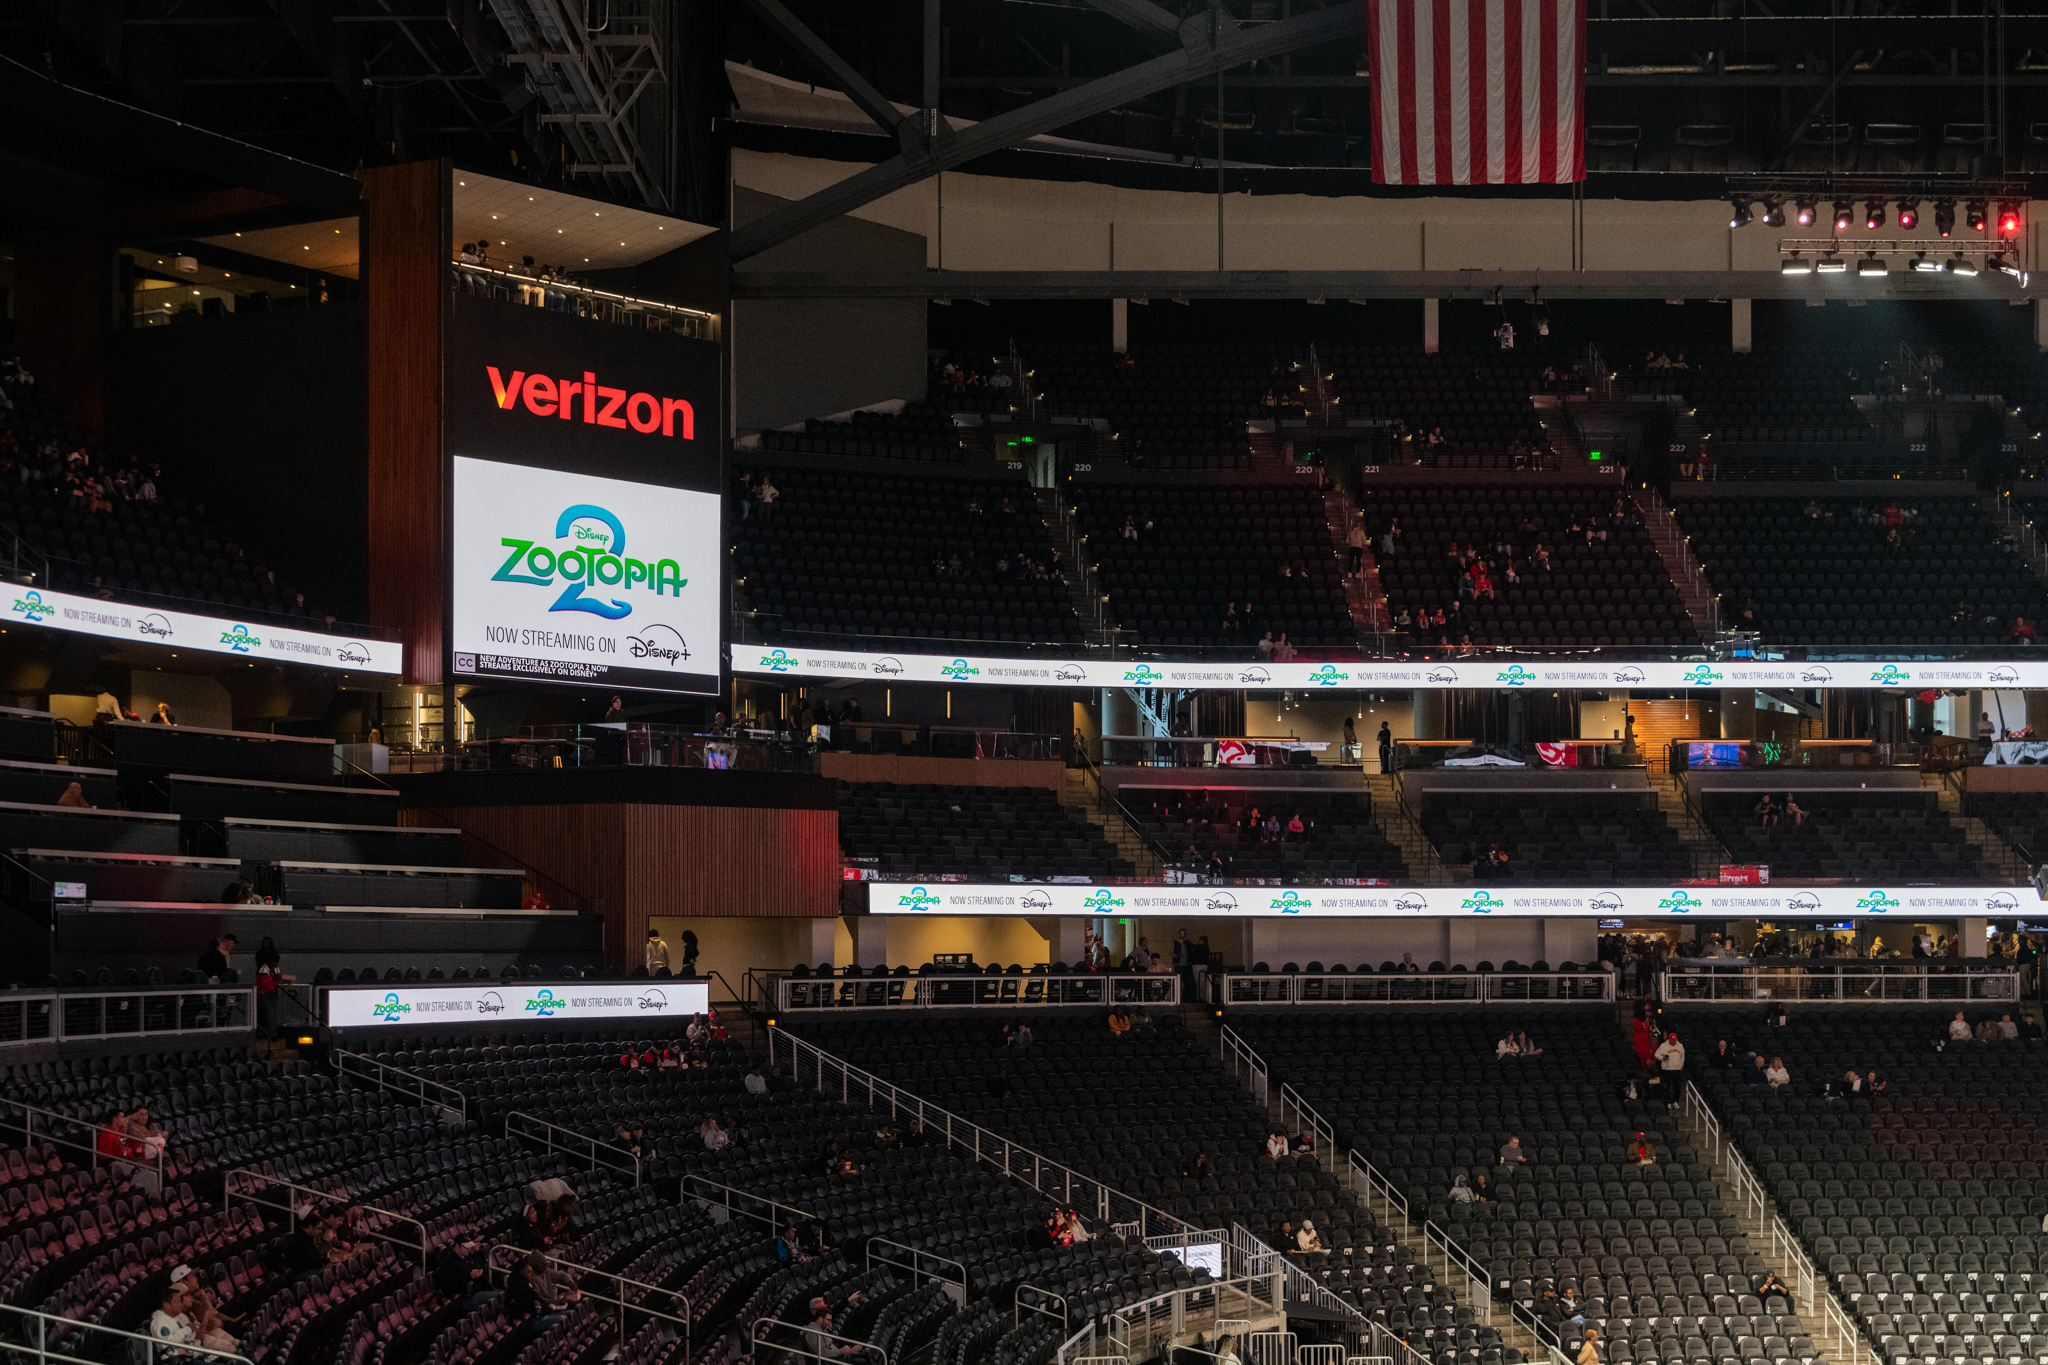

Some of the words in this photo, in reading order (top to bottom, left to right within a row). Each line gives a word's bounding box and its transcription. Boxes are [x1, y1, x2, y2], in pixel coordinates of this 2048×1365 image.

[486, 365, 694, 440] verizon
[573, 524, 609, 545] Disney
[491, 537, 688, 597] ZOOTOPIA
[548, 504, 633, 620] 2
[64, 608, 79, 620] NOW
[81, 611, 119, 626] STREAMING
[121, 617, 131, 628] ON
[137, 619, 173, 639] Disney+
[270, 639, 285, 649] NOW
[287, 641, 320, 655] STREAMING
[323, 647, 331, 656] ON
[337, 649, 372, 666] Disney+
[486, 625, 518, 643] NOW
[522, 629, 595, 652] STREAMING
[598, 637, 616, 653] ON
[626, 635, 691, 666] Disney+
[458, 658, 473, 667] CC
[480, 662, 511, 670] STREAMS
[513, 664, 556, 674] EXCLUSIVELY
[498, 657, 538, 666] ADVENTURE
[550, 661, 583, 670] ZOOTOPIA
[823, 660, 856, 669] STREAMING
[858, 662, 867, 670] ON
[872, 662, 904, 676] Disney+
[988, 668, 1003, 676] NOW
[1005, 669, 1038, 677] STREAMING
[1054, 670, 1087, 682] Disney+
[1238, 672, 1271, 684] Disney+
[1426, 672, 1459, 684] Disney+
[1545, 672, 1560, 680] NOW
[1562, 672, 1597, 680] STREAMING
[1599, 672, 1608, 680] ON
[1613, 672, 1646, 684] Disney+
[1800, 672, 1833, 684] Disney+
[1987, 672, 2020, 683] Disney+
[950, 896, 965, 904] NOW
[967, 897, 1004, 905] STREAMING
[1006, 897, 1015, 905] ON
[1020, 897, 1053, 910] Disney+
[1134, 898, 1150, 906] NOW
[1152, 898, 1188, 907] STREAMING
[1205, 899, 1238, 912] Disney+
[1393, 899, 1428, 912] Disney+
[1514, 899, 1530, 907] NOW
[1532, 899, 1571, 907] STREAMING
[1572, 899, 1582, 907] ON
[1588, 899, 1624, 911] Disney+
[1712, 899, 1728, 907] NOW
[1730, 899, 1768, 907] STREAMING
[1786, 899, 1822, 911] Disney+
[1984, 899, 2020, 911] Disney+
[417, 1002, 429, 1012] NOW
[431, 1001, 463, 1011] STREAMING
[464, 1001, 472, 1010] ON
[477, 1000, 505, 1015] Disney+
[572, 998, 586, 1008] NOW
[588, 998, 622, 1007] STREAMING
[624, 997, 632, 1006] ON
[637, 997, 668, 1011] Disney+
